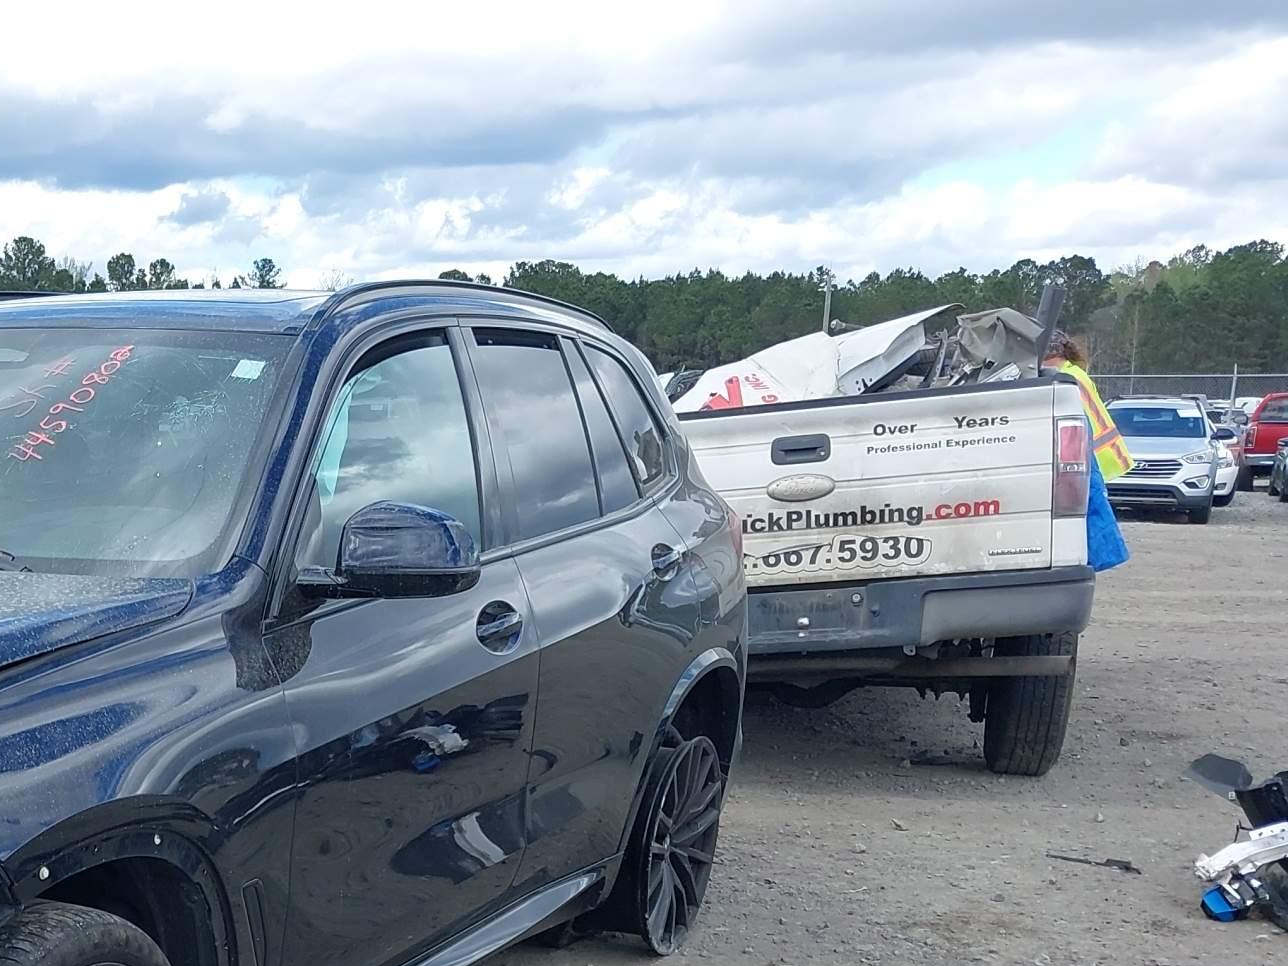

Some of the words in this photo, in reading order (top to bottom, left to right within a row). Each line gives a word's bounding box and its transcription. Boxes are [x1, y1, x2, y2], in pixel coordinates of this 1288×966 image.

[872, 423, 918, 437] Over
[953, 415, 1010, 430] Years
[866, 440, 942, 455] Professional
[945, 435, 1016, 449] Experience
